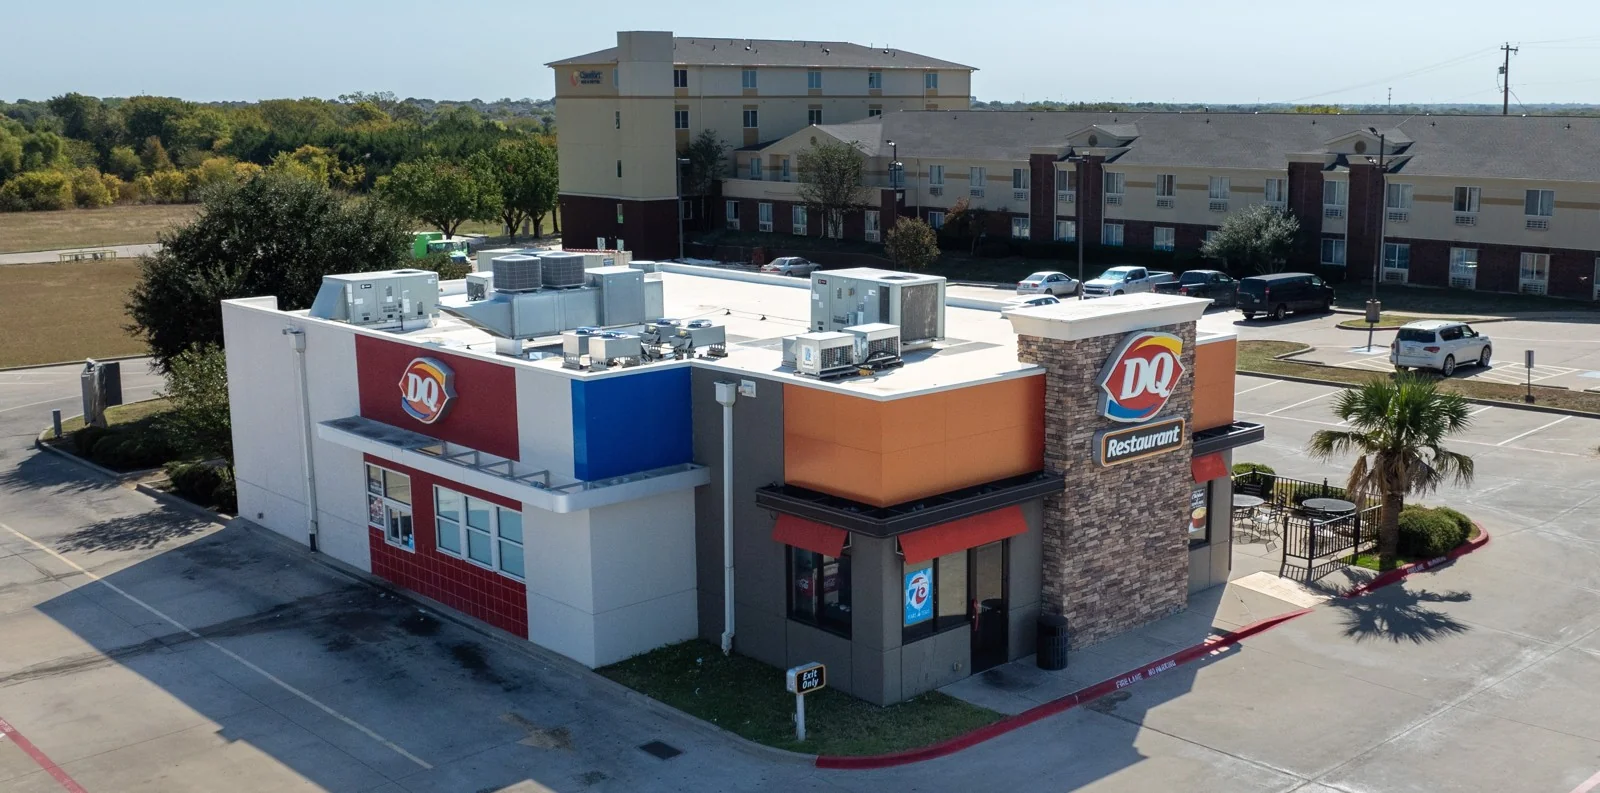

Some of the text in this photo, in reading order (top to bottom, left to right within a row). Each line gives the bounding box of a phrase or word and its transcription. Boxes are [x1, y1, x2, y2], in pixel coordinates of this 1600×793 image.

[1120, 352, 1174, 400] DQ
[407, 373, 439, 412] DQ
[1107, 425, 1180, 458] Restaurant
[803, 669, 818, 681] Exit
[803, 677, 819, 690] Only
[1116, 678, 1129, 689] FIRE
[1147, 667, 1156, 677] NO
[1155, 660, 1176, 674] PARKING
